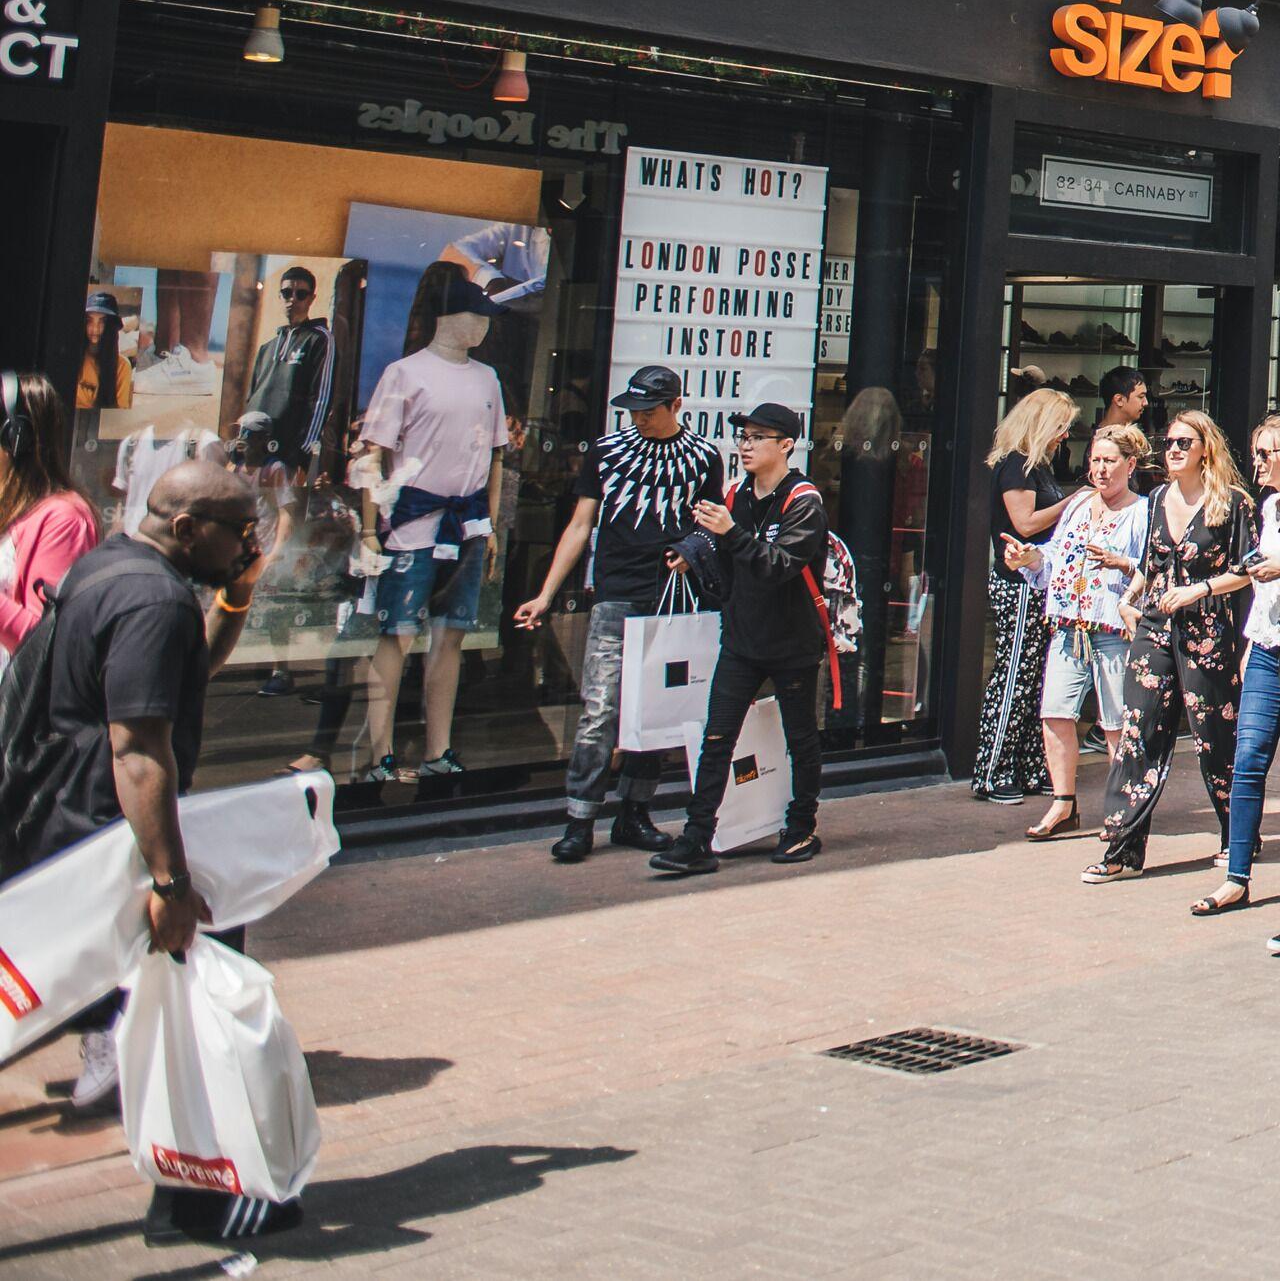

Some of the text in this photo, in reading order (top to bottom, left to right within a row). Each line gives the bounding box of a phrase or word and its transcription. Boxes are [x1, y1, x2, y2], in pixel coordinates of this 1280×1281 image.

[641, 157, 802, 199] WHATS HOT?
[1114, 182, 1186, 202] CARNABY
[625, 239, 811, 280] LONDON POSSE
[635, 283, 794, 318] PERFORMING
[667, 327, 773, 358] INSTORE
[682, 369, 741, 398] LIVE
[157, 1148, 235, 1186] Supreme
